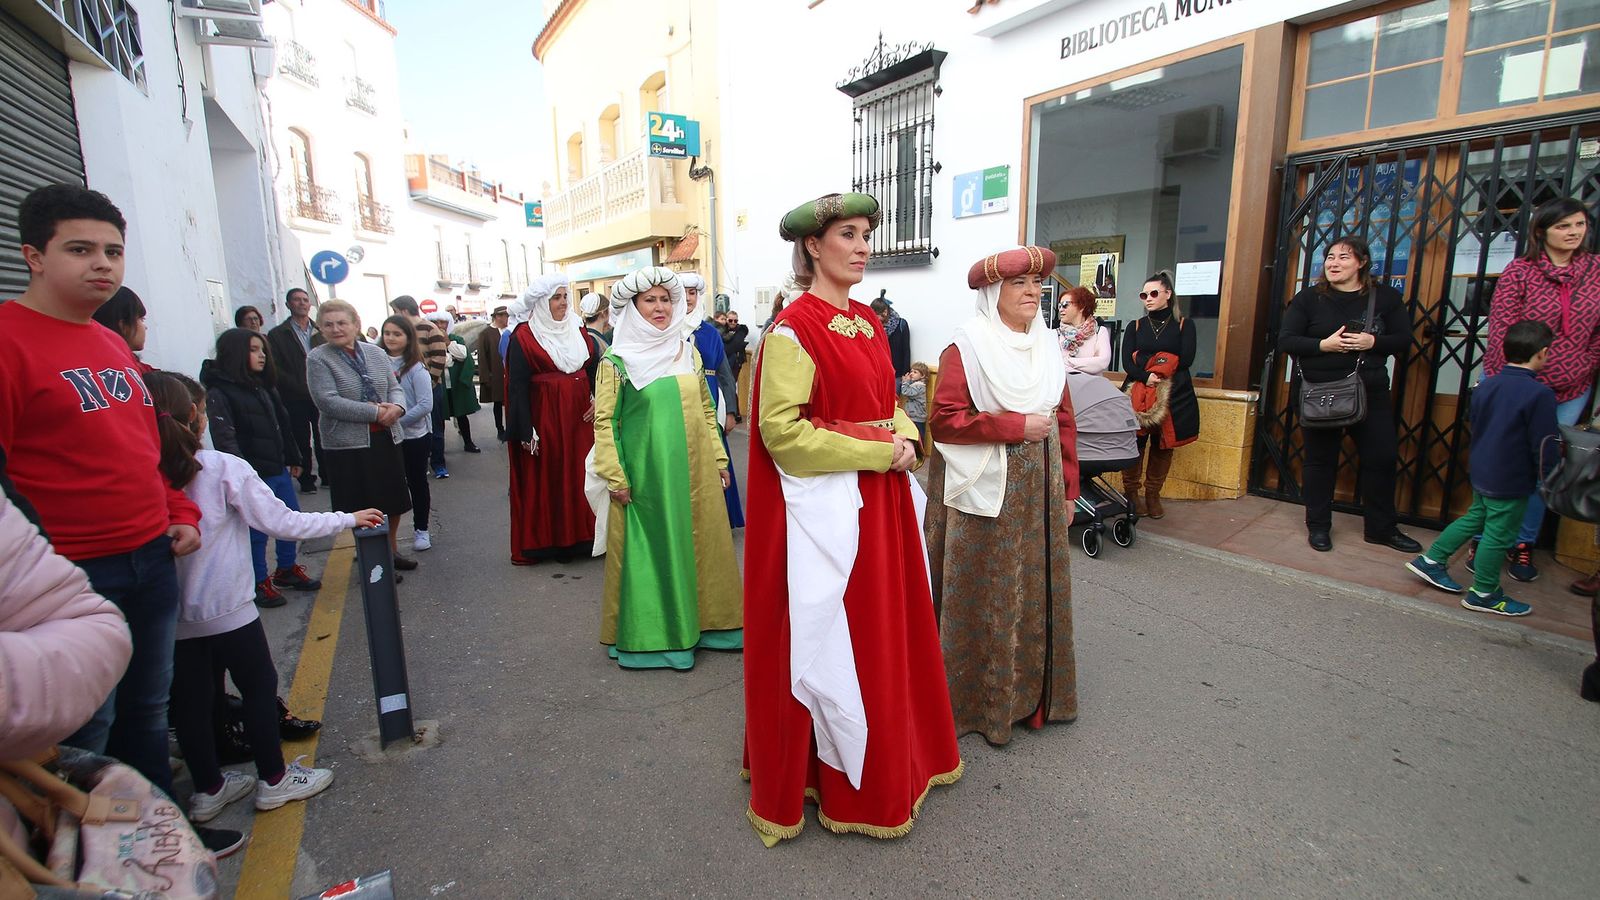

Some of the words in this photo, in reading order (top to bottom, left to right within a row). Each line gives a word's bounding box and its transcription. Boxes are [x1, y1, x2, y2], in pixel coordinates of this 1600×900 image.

[1060, 2, 1169, 59] BIBLIOTECA
[650, 114, 686, 142] 24h
[292, 776, 308, 784] FILA
